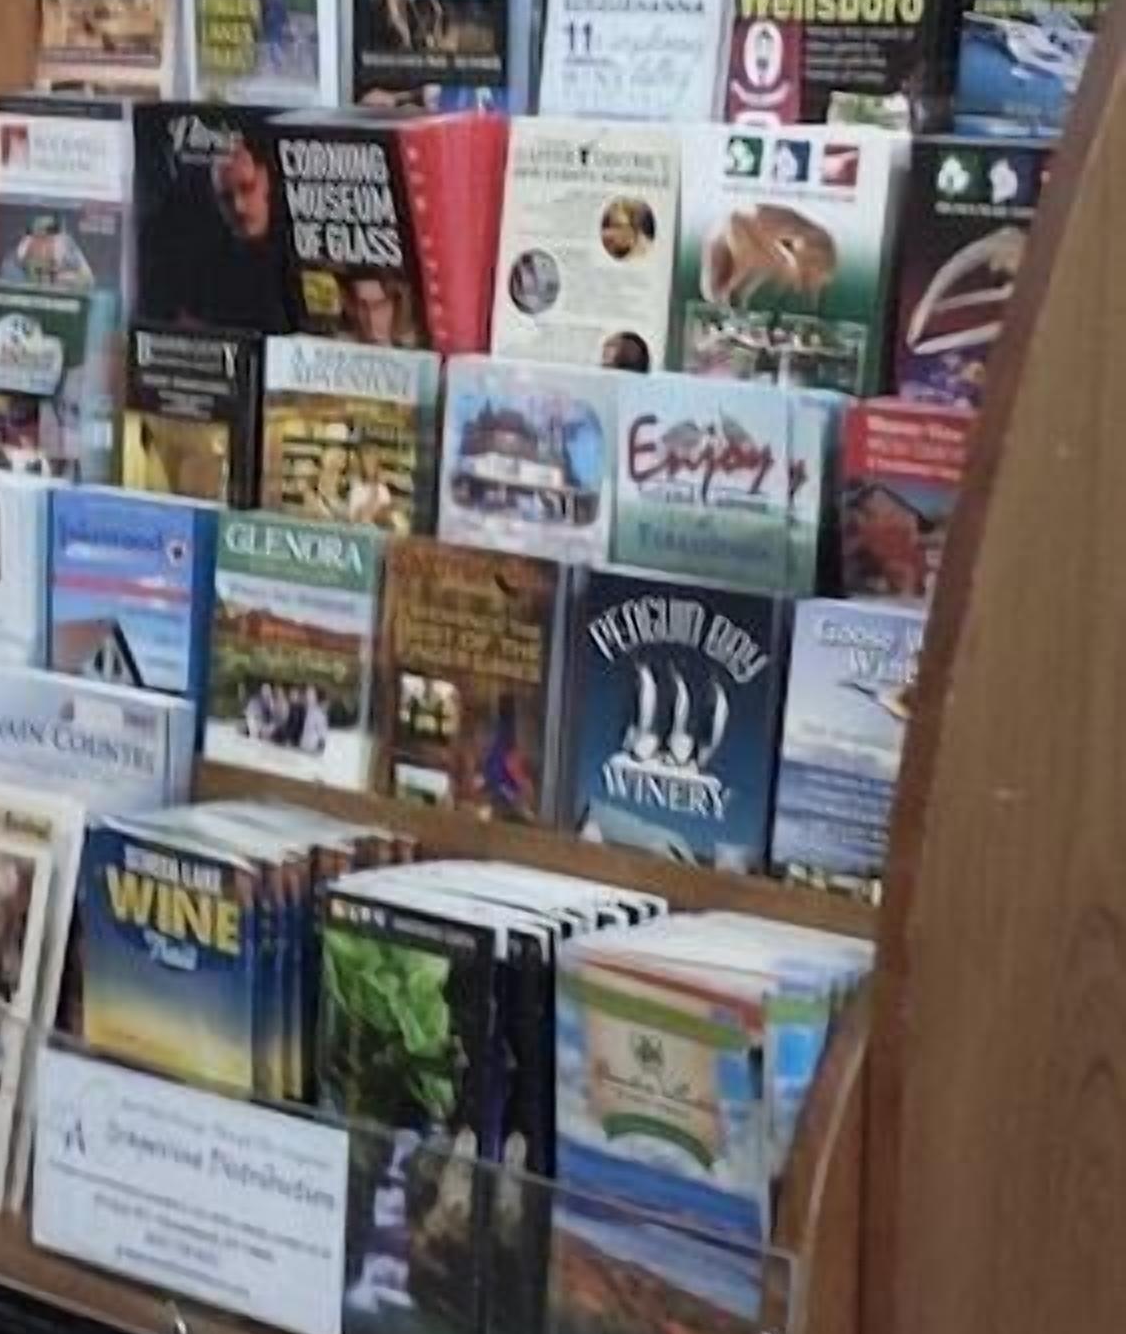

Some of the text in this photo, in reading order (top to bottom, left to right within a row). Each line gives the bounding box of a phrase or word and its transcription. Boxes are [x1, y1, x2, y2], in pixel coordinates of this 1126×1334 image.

[278, 138, 390, 183] CORNING
[285, 180, 398, 225] MUSEUM
[294, 220, 404, 268] OF GLASS
[628, 415, 774, 506] Enjoy
[225, 522, 363, 575] GLENORA
[601, 751, 736, 822] WINERY
[104, 862, 242, 958] WINE
